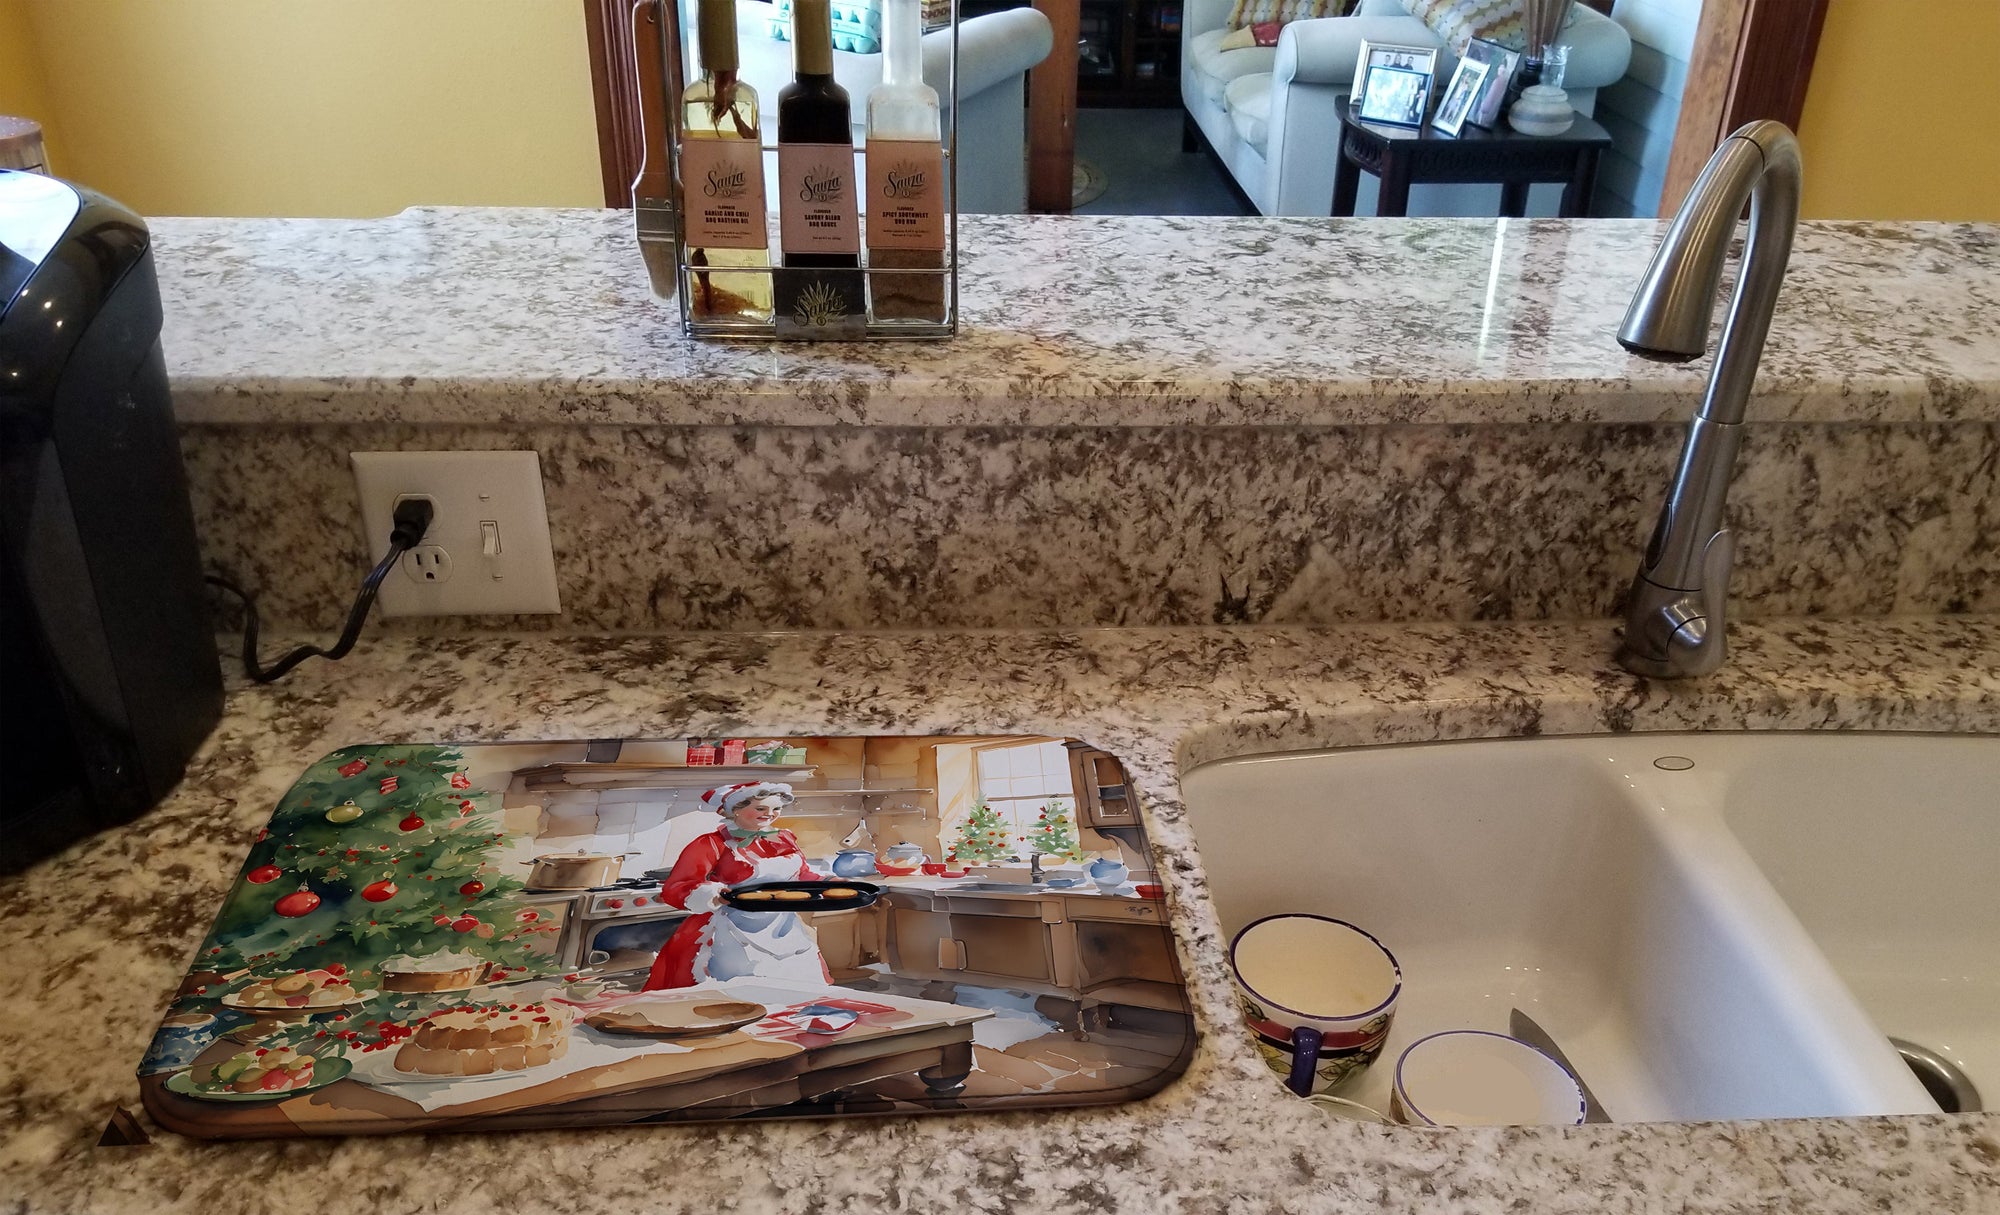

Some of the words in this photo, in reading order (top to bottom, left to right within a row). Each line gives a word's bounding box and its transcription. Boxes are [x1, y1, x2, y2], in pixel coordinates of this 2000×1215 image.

[704, 170, 745, 197] Sauza
[800, 175, 841, 202] Sauza
[883, 171, 925, 198] Sauza
[793, 295, 846, 326] Sauza
